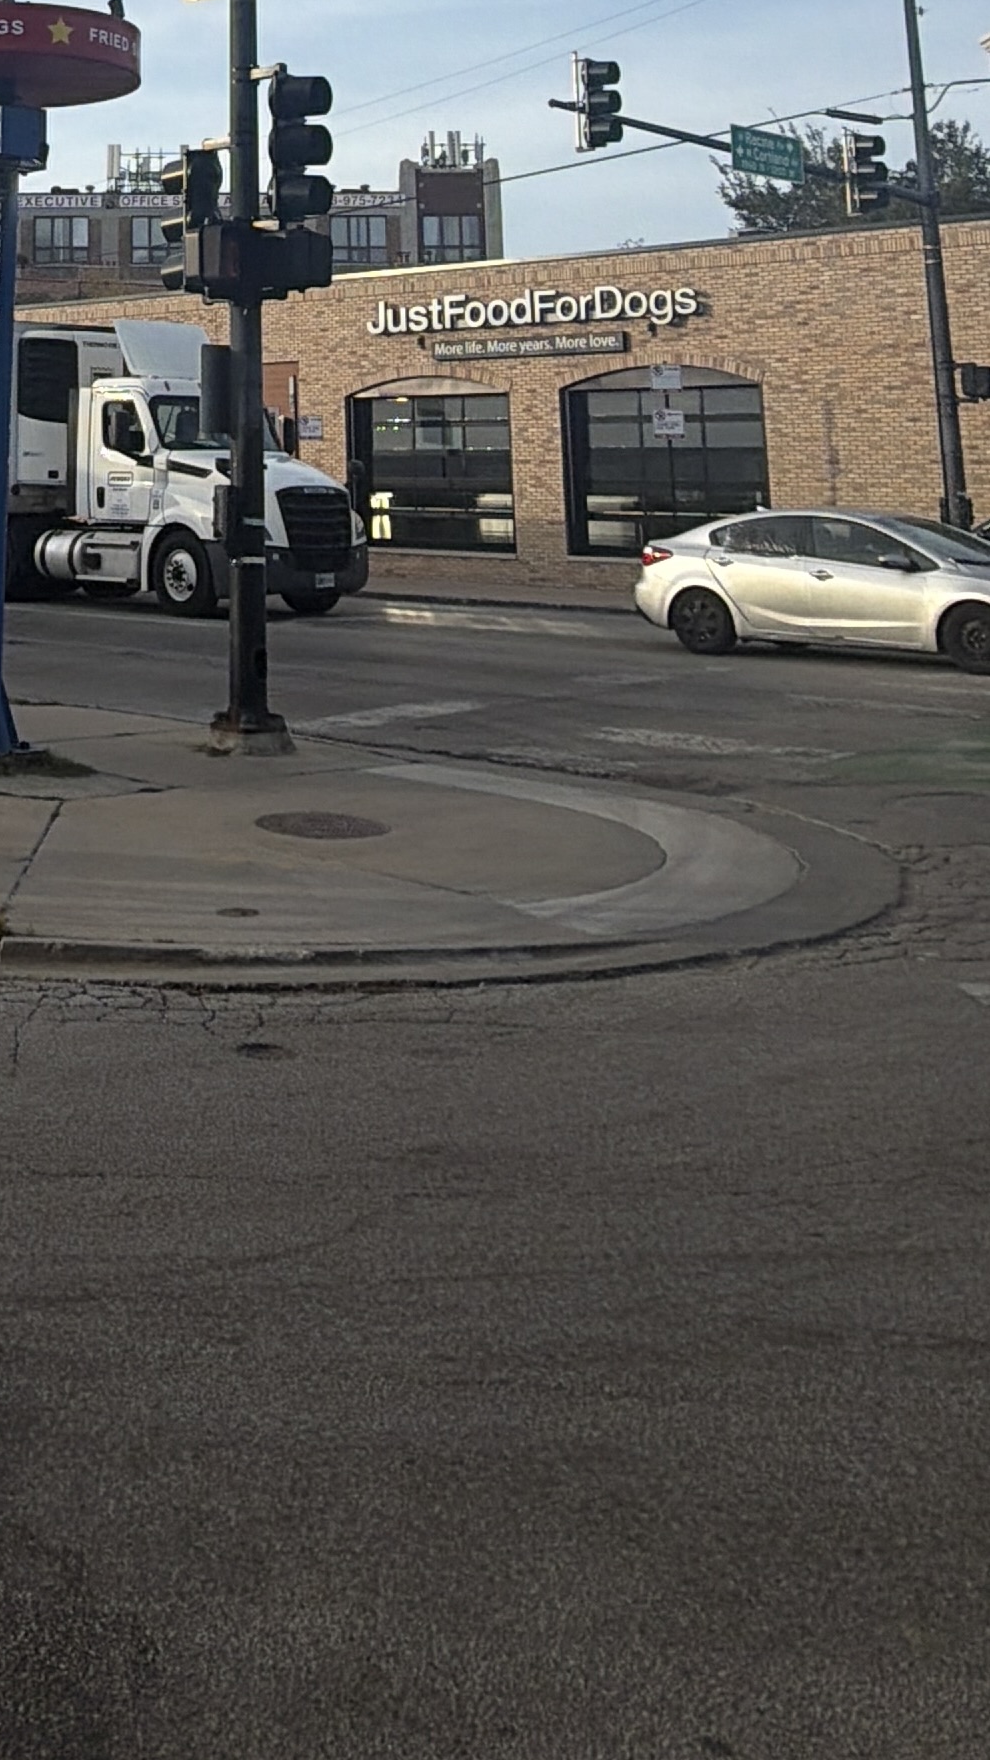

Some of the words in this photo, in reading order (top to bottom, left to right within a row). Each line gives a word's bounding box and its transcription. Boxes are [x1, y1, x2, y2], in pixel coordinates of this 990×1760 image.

[89, 27, 130, 52] FRIED
[122, 195, 167, 207] OFFICE
[366, 285, 698, 334] JustFoodForDogs
[434, 341, 464, 356] More
[465, 340, 486, 355] life.
[487, 339, 517, 354] More
[519, 338, 554, 355] years.
[555, 336, 587, 350] More
[589, 333, 620, 349] love.
